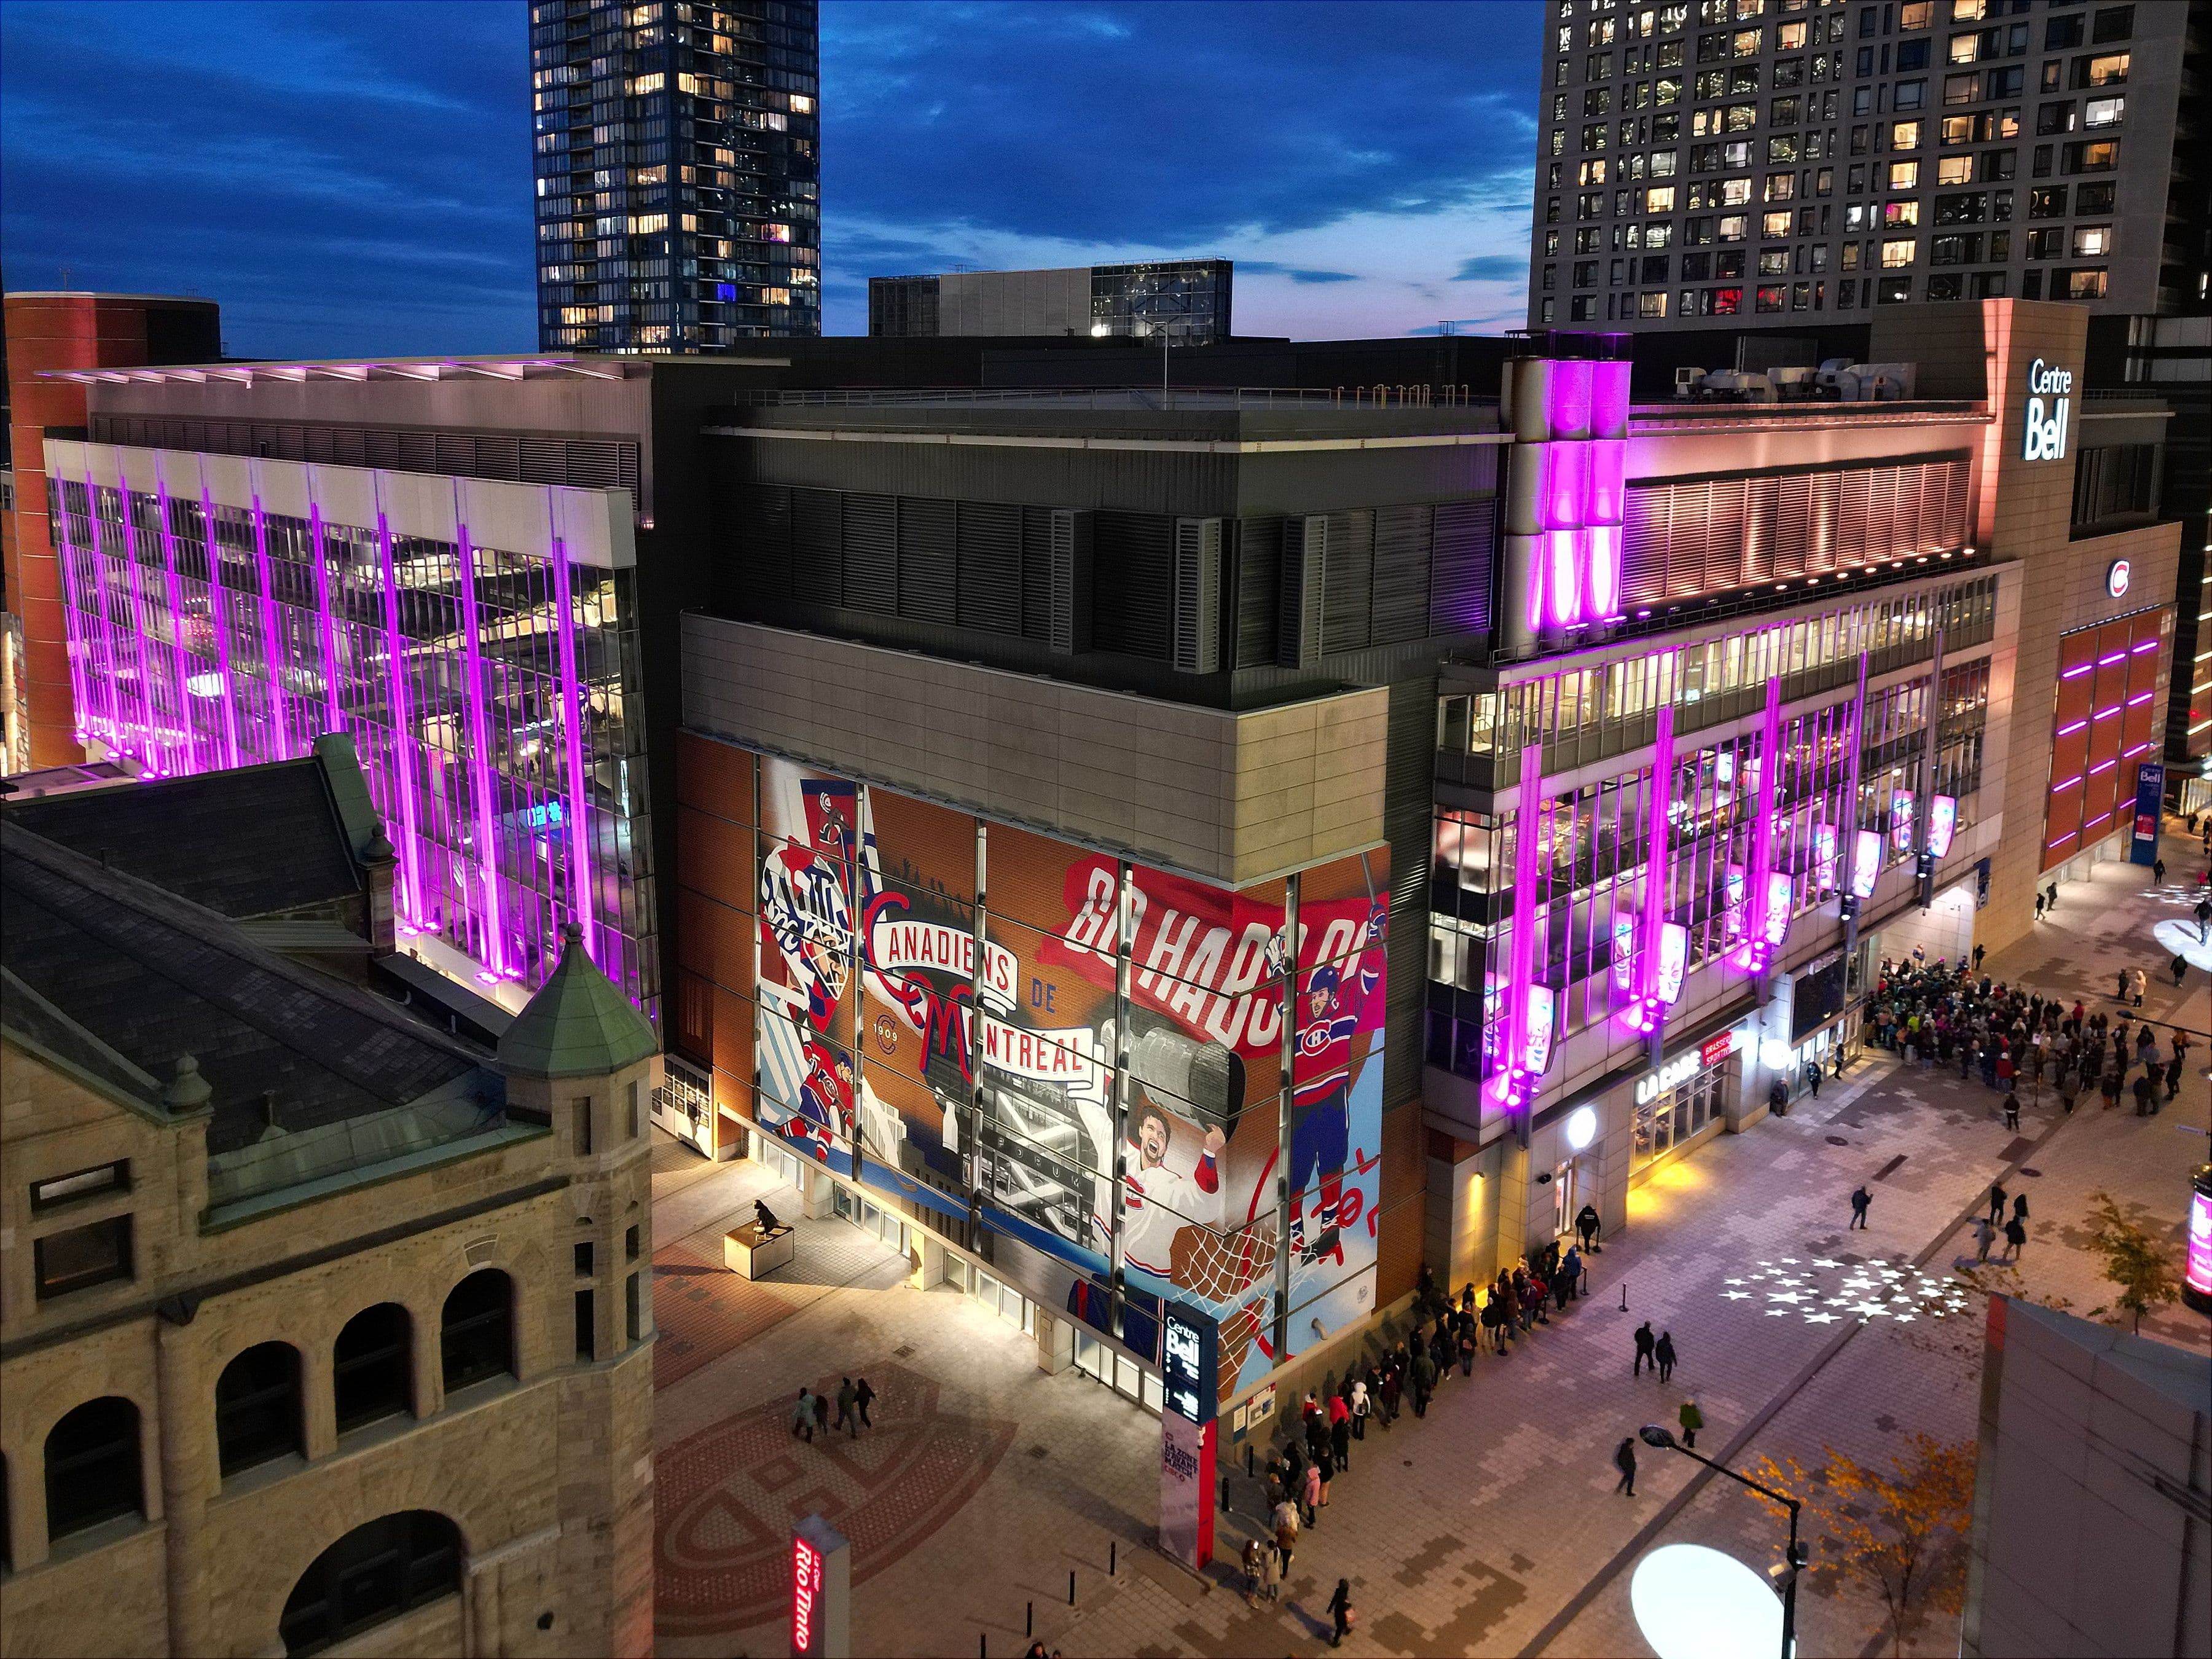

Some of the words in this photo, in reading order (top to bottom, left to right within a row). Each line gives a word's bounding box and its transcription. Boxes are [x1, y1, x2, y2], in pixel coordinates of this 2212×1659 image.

[2031, 358, 2072, 394] Centre
[2024, 397, 2070, 461] Bell
[2141, 771, 2160, 783] Bell
[1064, 867, 1148, 968] GO
[1032, 978, 1057, 1014] DE
[873, 1022, 898, 1042] 1909
[1166, 1327, 1199, 1367] Bell
[1167, 1316, 1199, 1343] Centre
[796, 1540, 812, 1586] Rio
[796, 1586, 812, 1650] Tinto
